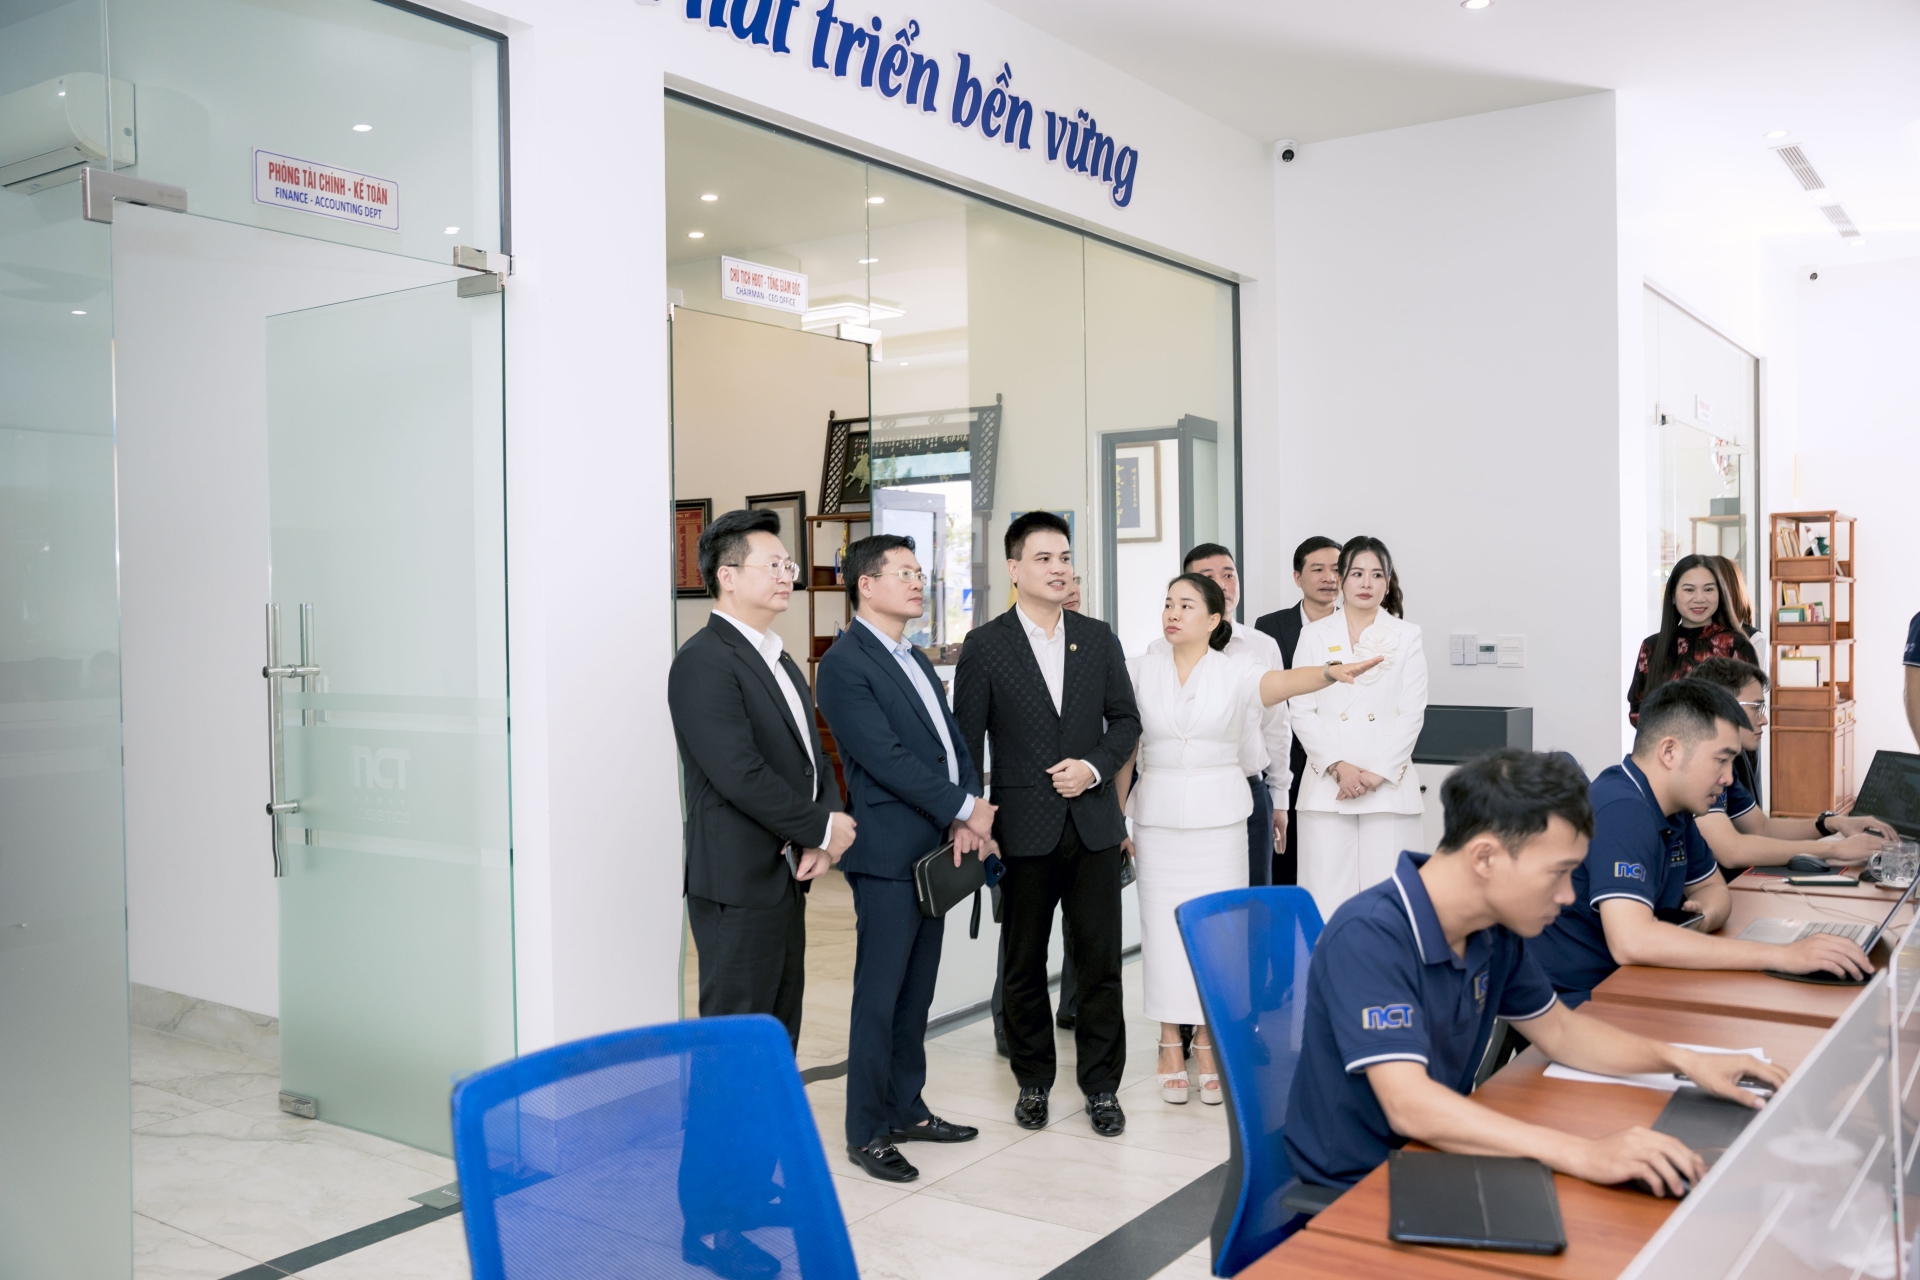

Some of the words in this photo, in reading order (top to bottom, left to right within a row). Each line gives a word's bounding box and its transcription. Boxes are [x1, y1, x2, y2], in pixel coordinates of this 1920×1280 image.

[811, 0, 938, 112] triển
[951, 52, 1032, 150] bền
[1045, 108, 1138, 207] vững
[268, 160, 300, 186] PHÒNG
[302, 166, 317, 190] TÀI
[319, 171, 346, 196] CHÍNH
[354, 177, 365, 200] KẾ
[366, 182, 388, 206] TOÁN
[275, 187, 309, 204] FINANCE
[315, 196, 363, 216] ACCOUNTING
[364, 206, 382, 220] DEPT
[736, 286, 765, 300] CHAIRMAN
[768, 293, 779, 303] CEO
[780, 296, 796, 306] OFFICE
